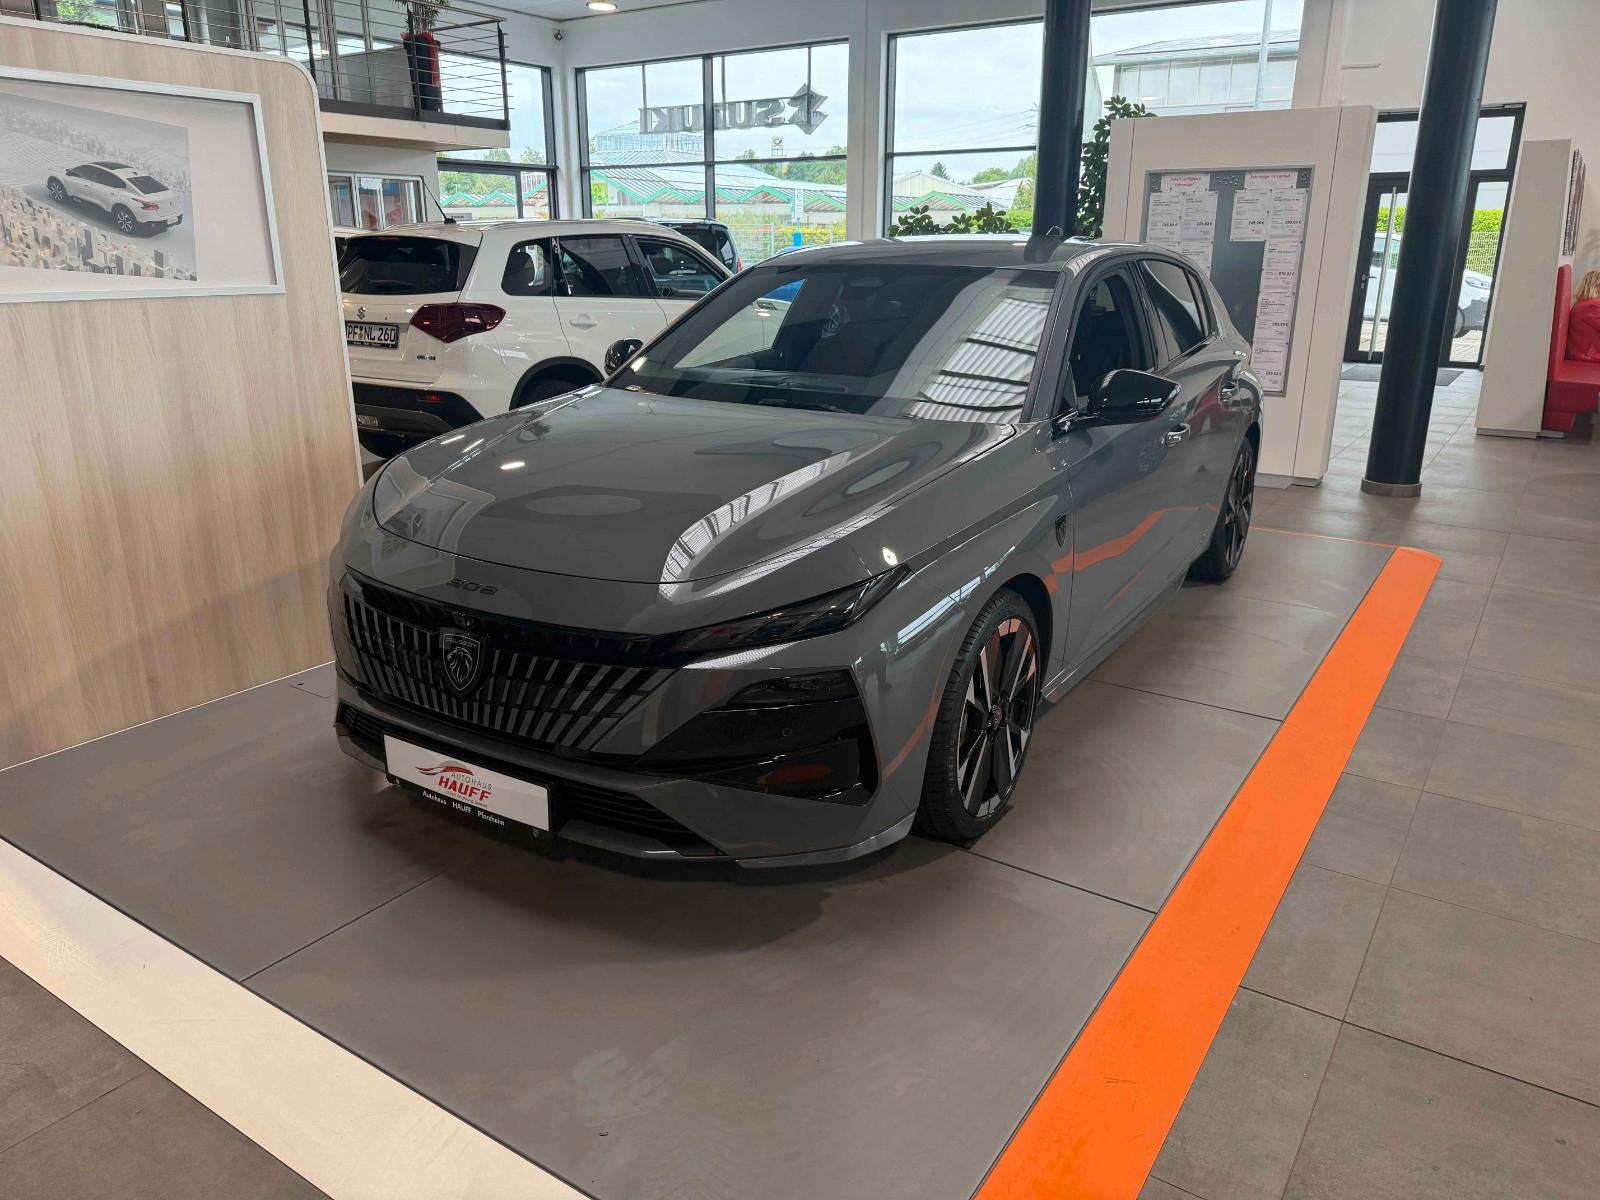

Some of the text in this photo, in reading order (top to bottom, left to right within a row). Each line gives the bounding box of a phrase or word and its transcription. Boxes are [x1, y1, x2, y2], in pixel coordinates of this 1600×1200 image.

[347, 324, 396, 342] PF NL 260
[438, 775, 492, 801] HAUFF
[450, 771, 493, 791] AUTOHAUS
[422, 789, 447, 805] Autohaus
[452, 801, 472, 814] HAUFF
